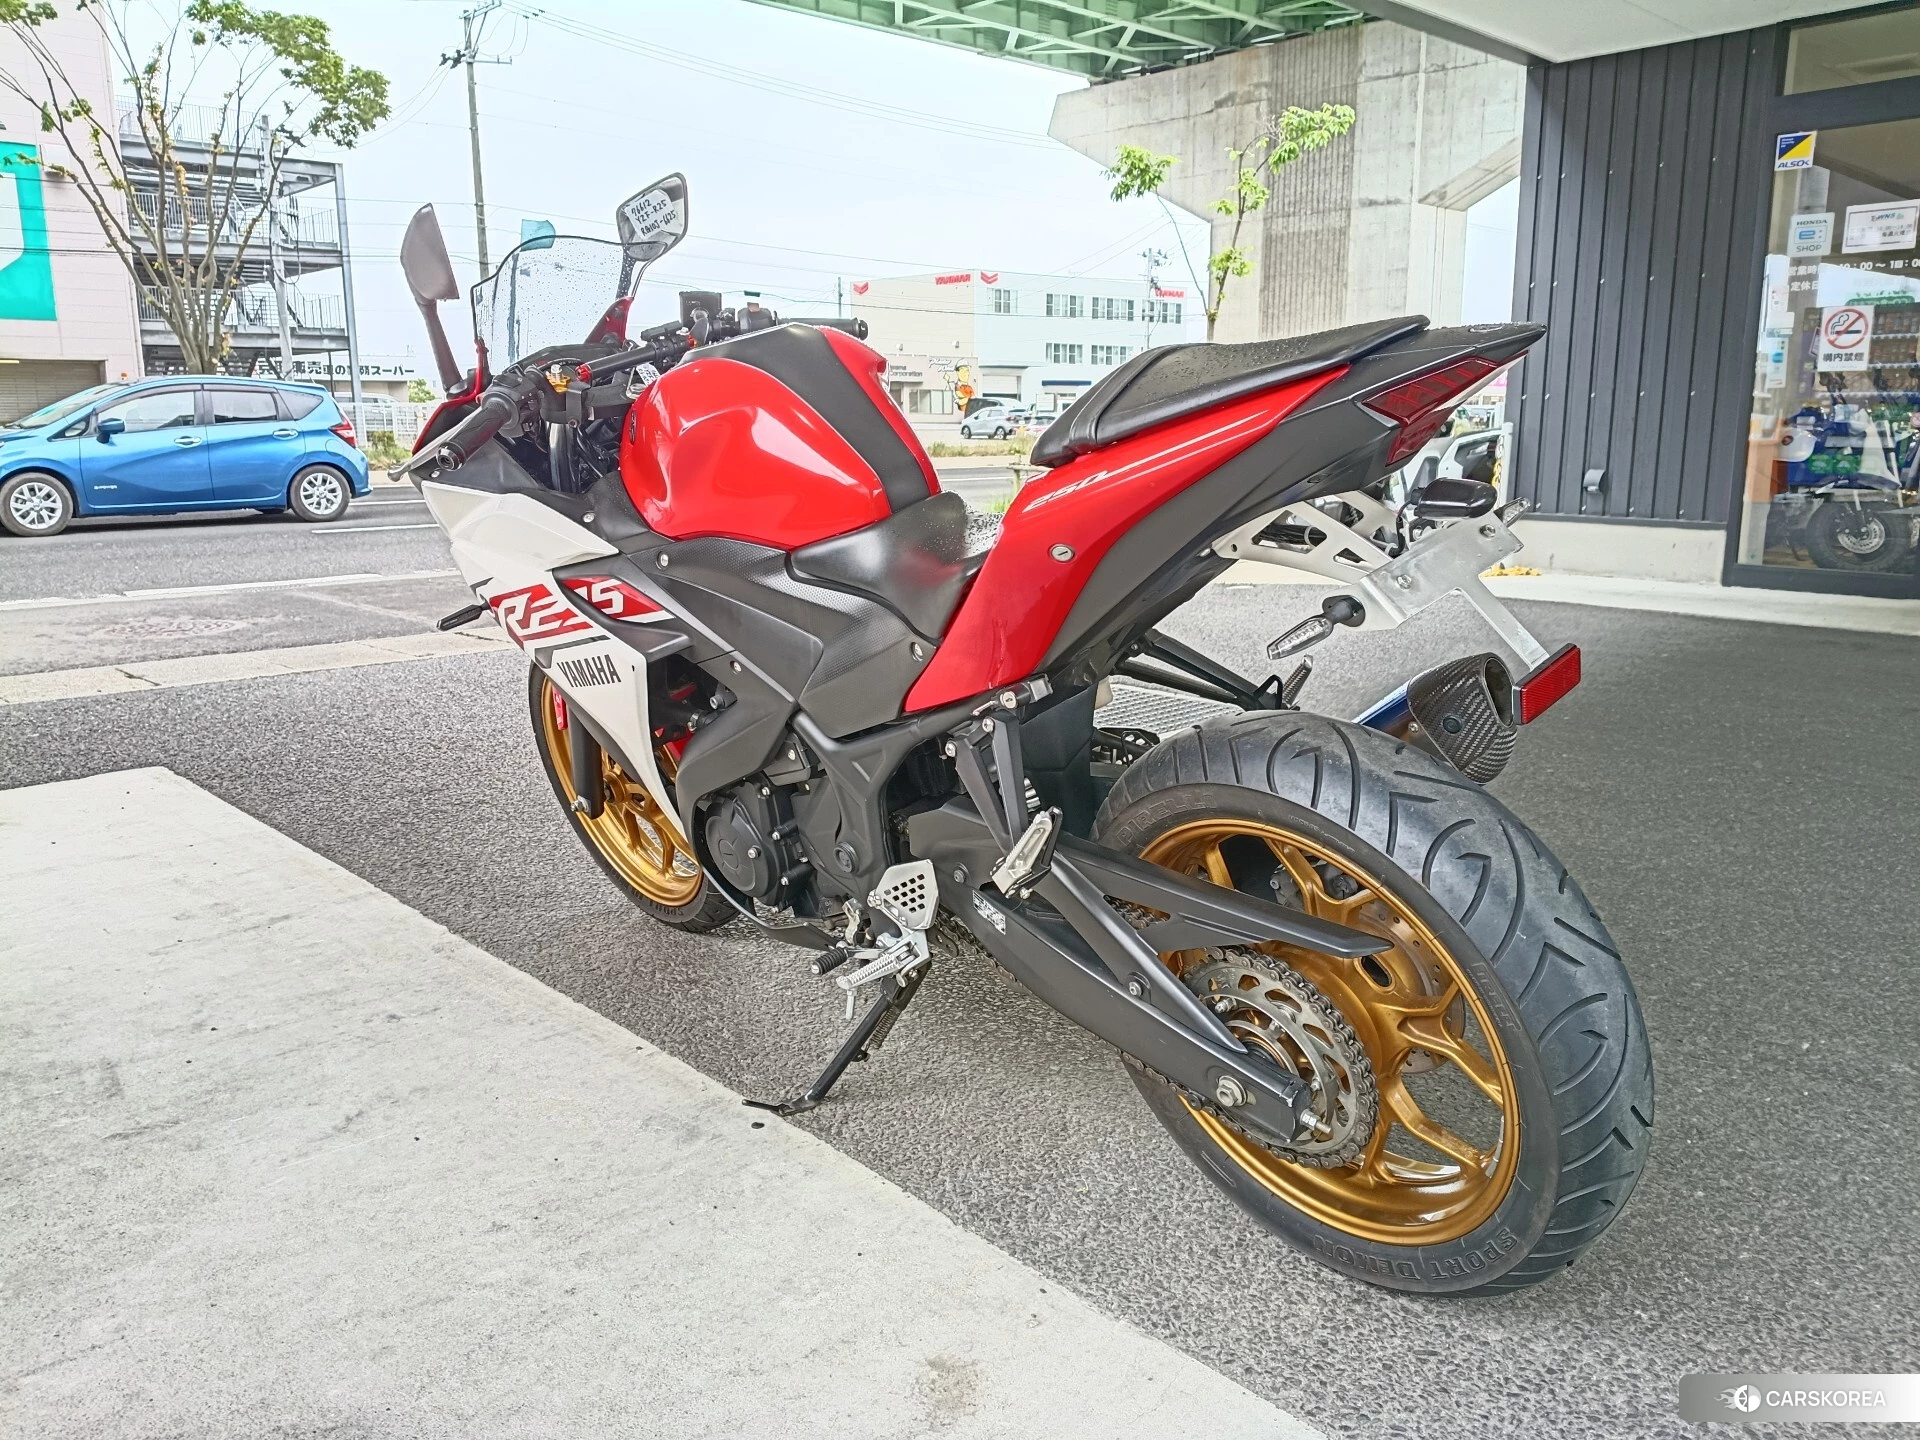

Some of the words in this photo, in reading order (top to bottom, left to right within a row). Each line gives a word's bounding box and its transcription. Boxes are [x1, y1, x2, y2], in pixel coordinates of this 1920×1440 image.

[1778, 160, 1810, 168] ALSOK
[635, 200, 667, 225] YZF-R25
[1796, 244, 1822, 253] SHOP
[935, 273, 971, 285] YANMAR
[556, 653, 622, 688] YAMAHA
[1313, 1234, 1421, 1280] DEMON
[1431, 1226, 1518, 1281] SPORT
